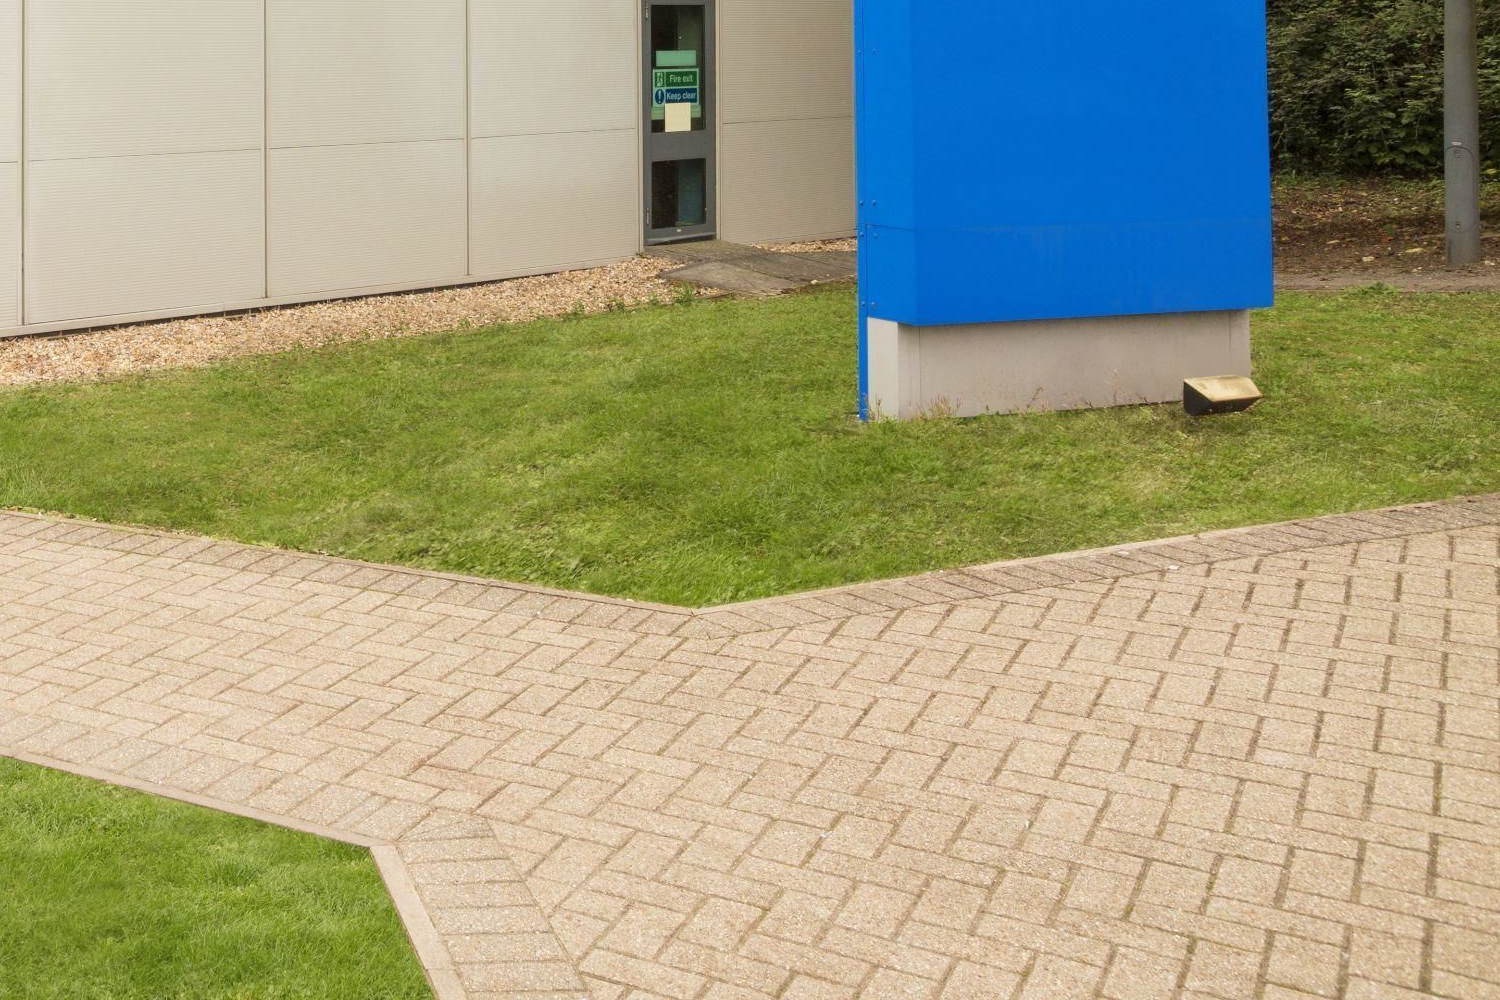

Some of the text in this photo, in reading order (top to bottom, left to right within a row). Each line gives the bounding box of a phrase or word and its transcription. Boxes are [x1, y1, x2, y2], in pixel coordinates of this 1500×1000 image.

[669, 74, 693, 83] Fire exit
[666, 91, 696, 102] Keep clear
